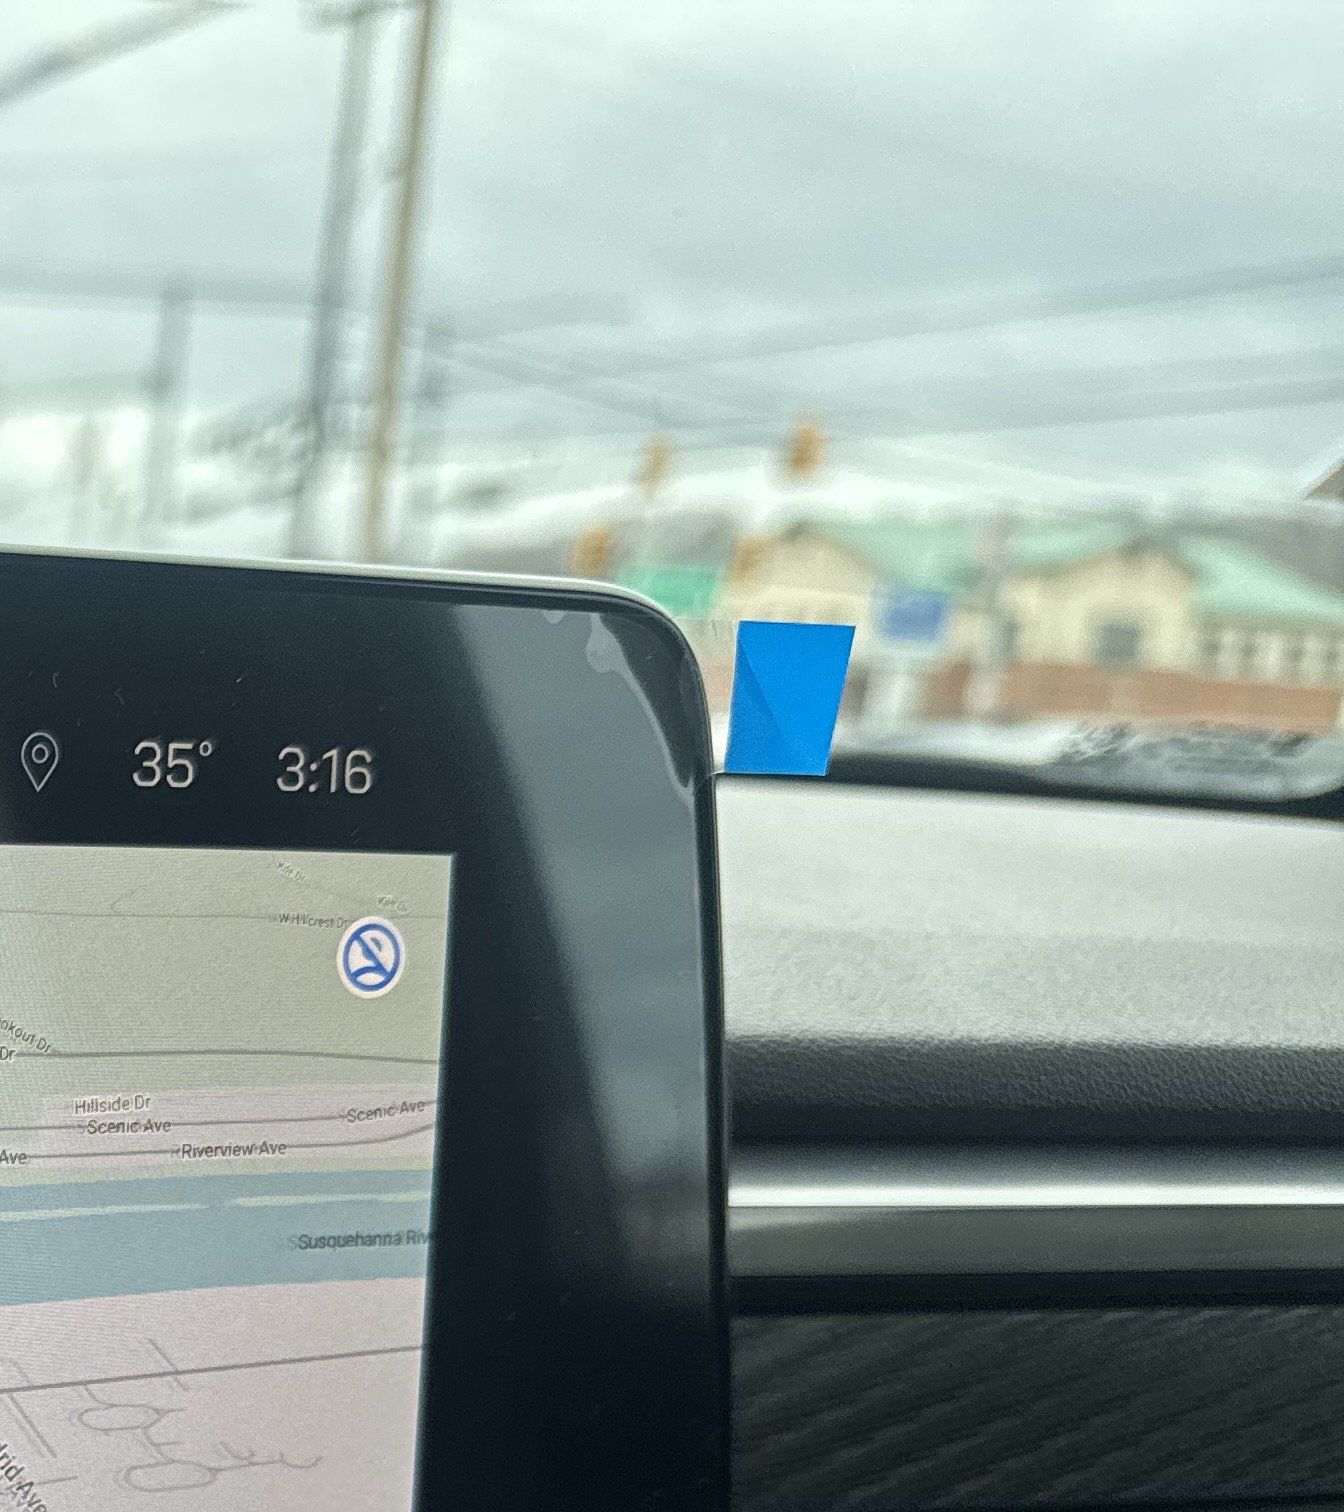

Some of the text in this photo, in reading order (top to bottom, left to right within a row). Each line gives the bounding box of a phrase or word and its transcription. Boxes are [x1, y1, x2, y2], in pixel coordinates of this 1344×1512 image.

[132, 740, 212, 789] 35°
[275, 747, 374, 795] 3:16
[290, 914, 335, 929] Hillcrest
[35, 1036, 53, 1053] Dr
[74, 1094, 151, 1115] Hillside Dr
[346, 1099, 426, 1124] Scenic Ave
[86, 1117, 172, 1134] Scenic Ave
[181, 1140, 287, 1159] Riverview Ave
[297, 1230, 404, 1252] Susquehanna
